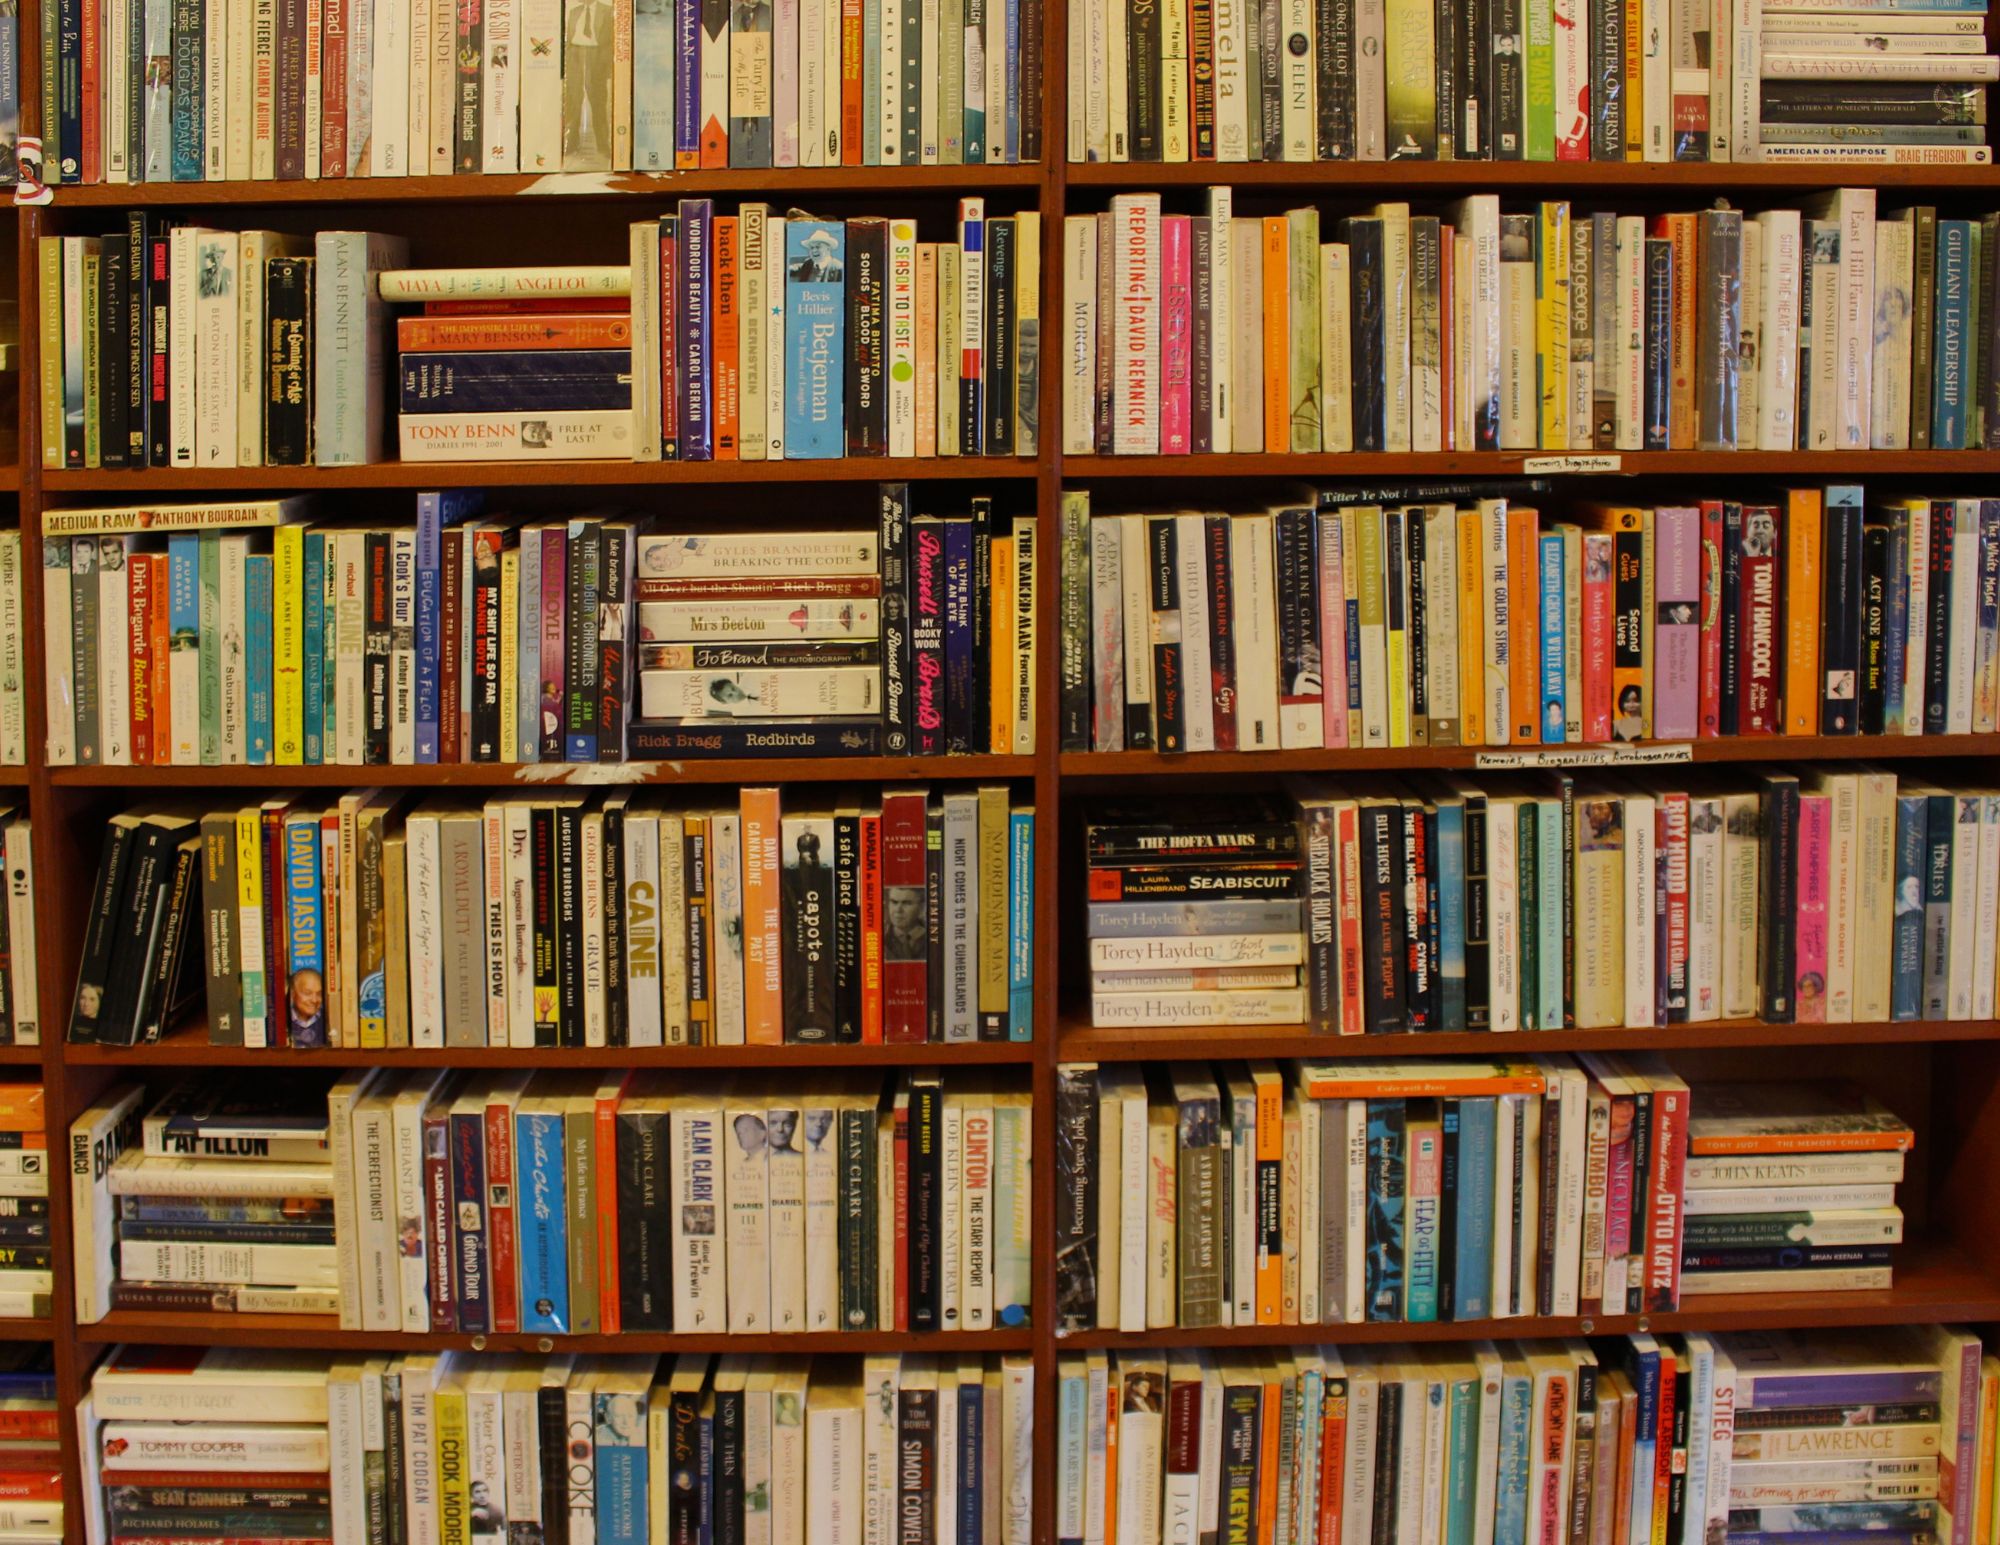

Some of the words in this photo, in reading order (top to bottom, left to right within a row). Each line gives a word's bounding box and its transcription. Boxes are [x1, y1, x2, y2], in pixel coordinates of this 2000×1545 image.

[1628, 3, 1637, 16] MY
[45, 39, 53, 57] THE
[257, 20, 269, 56] FIERCE
[1194, 11, 1210, 59] EARHART
[1628, 20, 1637, 54] SILENT
[45, 61, 53, 78] EYE
[178, 37, 189, 106] DOUGLAS
[257, 60, 272, 97] CARMEN
[1531, 48, 1550, 105] EVANS
[1628, 58, 1637, 79] WAR
[45, 82, 53, 93] OF
[463, 83, 477, 102] Nick
[1293, 64, 1305, 110] ELENI
[45, 97, 53, 141] PARADISE
[178, 110, 189, 160] ADAMS
[256, 102, 271, 140] AGUIRRE
[463, 104, 476, 140] Tosches
[1895, 149, 1920, 162] CRAIG
[1924, 150, 1966, 163] FERGUSON
[336, 240, 348, 277] ALAN
[690, 220, 700, 278] WONDROUS
[719, 225, 733, 268] back
[1129, 208, 1145, 292] REPORTING
[1199, 231, 1208, 267] JANET
[1947, 229, 1961, 298] GIULIANI
[400, 280, 442, 292] MAYA
[515, 277, 588, 290] ANGELOU
[861, 253, 870, 291] SONGS
[896, 247, 910, 291] SEASON
[690, 284, 700, 323] BEAUTY
[720, 273, 734, 314] then
[871, 282, 880, 323] FATIMA
[896, 296, 910, 310] TO
[1199, 272, 1209, 309] FRAME
[336, 285, 348, 352] BENNETT
[861, 306, 870, 344] BLOOD
[896, 315, 909, 348] TASTE
[1130, 306, 1145, 351] DAVID
[690, 345, 700, 378] CAROL
[871, 331, 880, 376] BHUTTO
[1944, 309, 1958, 406] LEADERSHIP
[806, 323, 834, 421] Betjeman
[861, 367, 870, 407] SWORD
[690, 383, 700, 421] BERKIN
[1129, 360, 1145, 426] REMNICK
[408, 426, 459, 438] TONY
[467, 424, 515, 438] BENN
[50, 518, 91, 530] MEDIUM
[104, 515, 134, 527] RAW
[155, 512, 205, 525] ANTHONY
[207, 510, 258, 522] BOURDAIN
[397, 540, 410, 548] A
[584, 540, 595, 559] THE
[1019, 528, 1032, 558] THE
[133, 562, 146, 594] Dirk
[397, 553, 411, 591] Cook's
[1019, 562, 1032, 614] NAKED
[1495, 564, 1506, 584] THE
[1753, 564, 1772, 605] TONY
[1871, 576, 1880, 602] ACT
[487, 587, 497, 605] MY
[583, 563, 596, 618] BRADBURY
[1495, 588, 1506, 626] GOLDEN
[130, 597, 146, 654] Bogarde
[397, 597, 409, 622] Tour
[487, 609, 496, 634] SHIT
[1869, 607, 1880, 635] ONE
[487, 637, 497, 660] LIFE
[1019, 616, 1032, 650] MAN
[1495, 631, 1507, 665] STRING
[1618, 616, 1627, 645] Lives
[1629, 610, 1639, 652] Second
[1753, 607, 1772, 679] HANCOCK
[487, 664, 497, 679] SO
[583, 622, 595, 686] CHRONICLES
[134, 659, 145, 721] Backcloth
[486, 683, 495, 703] FAR
[571, 693, 581, 729] WELLER
[583, 702, 592, 720] SAM
[638, 736, 670, 746] Rick
[677, 734, 721, 749] Bragg
[746, 733, 815, 746] Redbirds
[840, 825, 850, 833] a
[1376, 815, 1387, 842] BILL
[1667, 801, 1684, 840] ROY
[291, 830, 313, 888] DAVID
[586, 826, 596, 876] GEORGE
[841, 838, 851, 865] safe
[1138, 837, 1165, 848] THE
[1170, 836, 1213, 847] HOFFA
[1217, 835, 1255, 845] WARS
[1310, 836, 1329, 893] SHERLOCK
[1377, 845, 1390, 883] HICKS
[1667, 846, 1685, 894] HUDD
[587, 880, 597, 919] BURNS
[837, 871, 852, 905] place
[1190, 876, 1290, 889] SEABISCUIT
[293, 896, 314, 956] JASON
[491, 902, 501, 938] THIS
[803, 891, 821, 961] capote
[929, 872, 938, 944] CASEMENT
[1312, 899, 1331, 943] HOLMES
[628, 881, 655, 977] CAINE
[491, 942, 501, 957] IS
[587, 935, 599, 992] GRACIE
[1098, 944, 1143, 964] Torey
[1148, 943, 1213, 959] Hayden
[492, 961, 502, 997] HOW
[367, 1122, 378, 1140] THE
[692, 1120, 712, 1154] ALAN
[74, 1135, 88, 1174] BANCO
[966, 1119, 988, 1189] CLINTON
[1589, 1133, 1604, 1197] JUMBO
[1712, 1166, 1751, 1178] JOHN
[1756, 1164, 1805, 1178] KEATS
[367, 1143, 383, 1222] PERFECTIONIST
[692, 1160, 712, 1201] CLARK
[970, 1196, 983, 1213] THE
[1415, 1200, 1433, 1235] FEAR
[1655, 1194, 1675, 1238] OTTO
[970, 1217, 983, 1247] STARR
[1419, 1238, 1428, 1249] OF
[970, 1250, 982, 1287] REPORT
[1415, 1251, 1433, 1287] FIFTY
[1653, 1245, 1673, 1288] KATZ
[411, 1394, 425, 1416] TIM
[482, 1403, 492, 1440] Peter
[1549, 1384, 1565, 1431] ANTHONY
[1713, 1388, 1733, 1440] STIEG
[140, 1442, 186, 1452] TOMMY
[192, 1441, 244, 1451] COOPER
[413, 1423, 427, 1445] PAT
[1549, 1435, 1561, 1460] LANE
[1787, 1431, 1893, 1451] LAWRENCE
[414, 1452, 429, 1503] COOGAN
[485, 1446, 495, 1479] Cook
[903, 1441, 922, 1489] SIMON
[1878, 1464, 1899, 1473] ROGER
[1903, 1464, 1918, 1473] LAW
